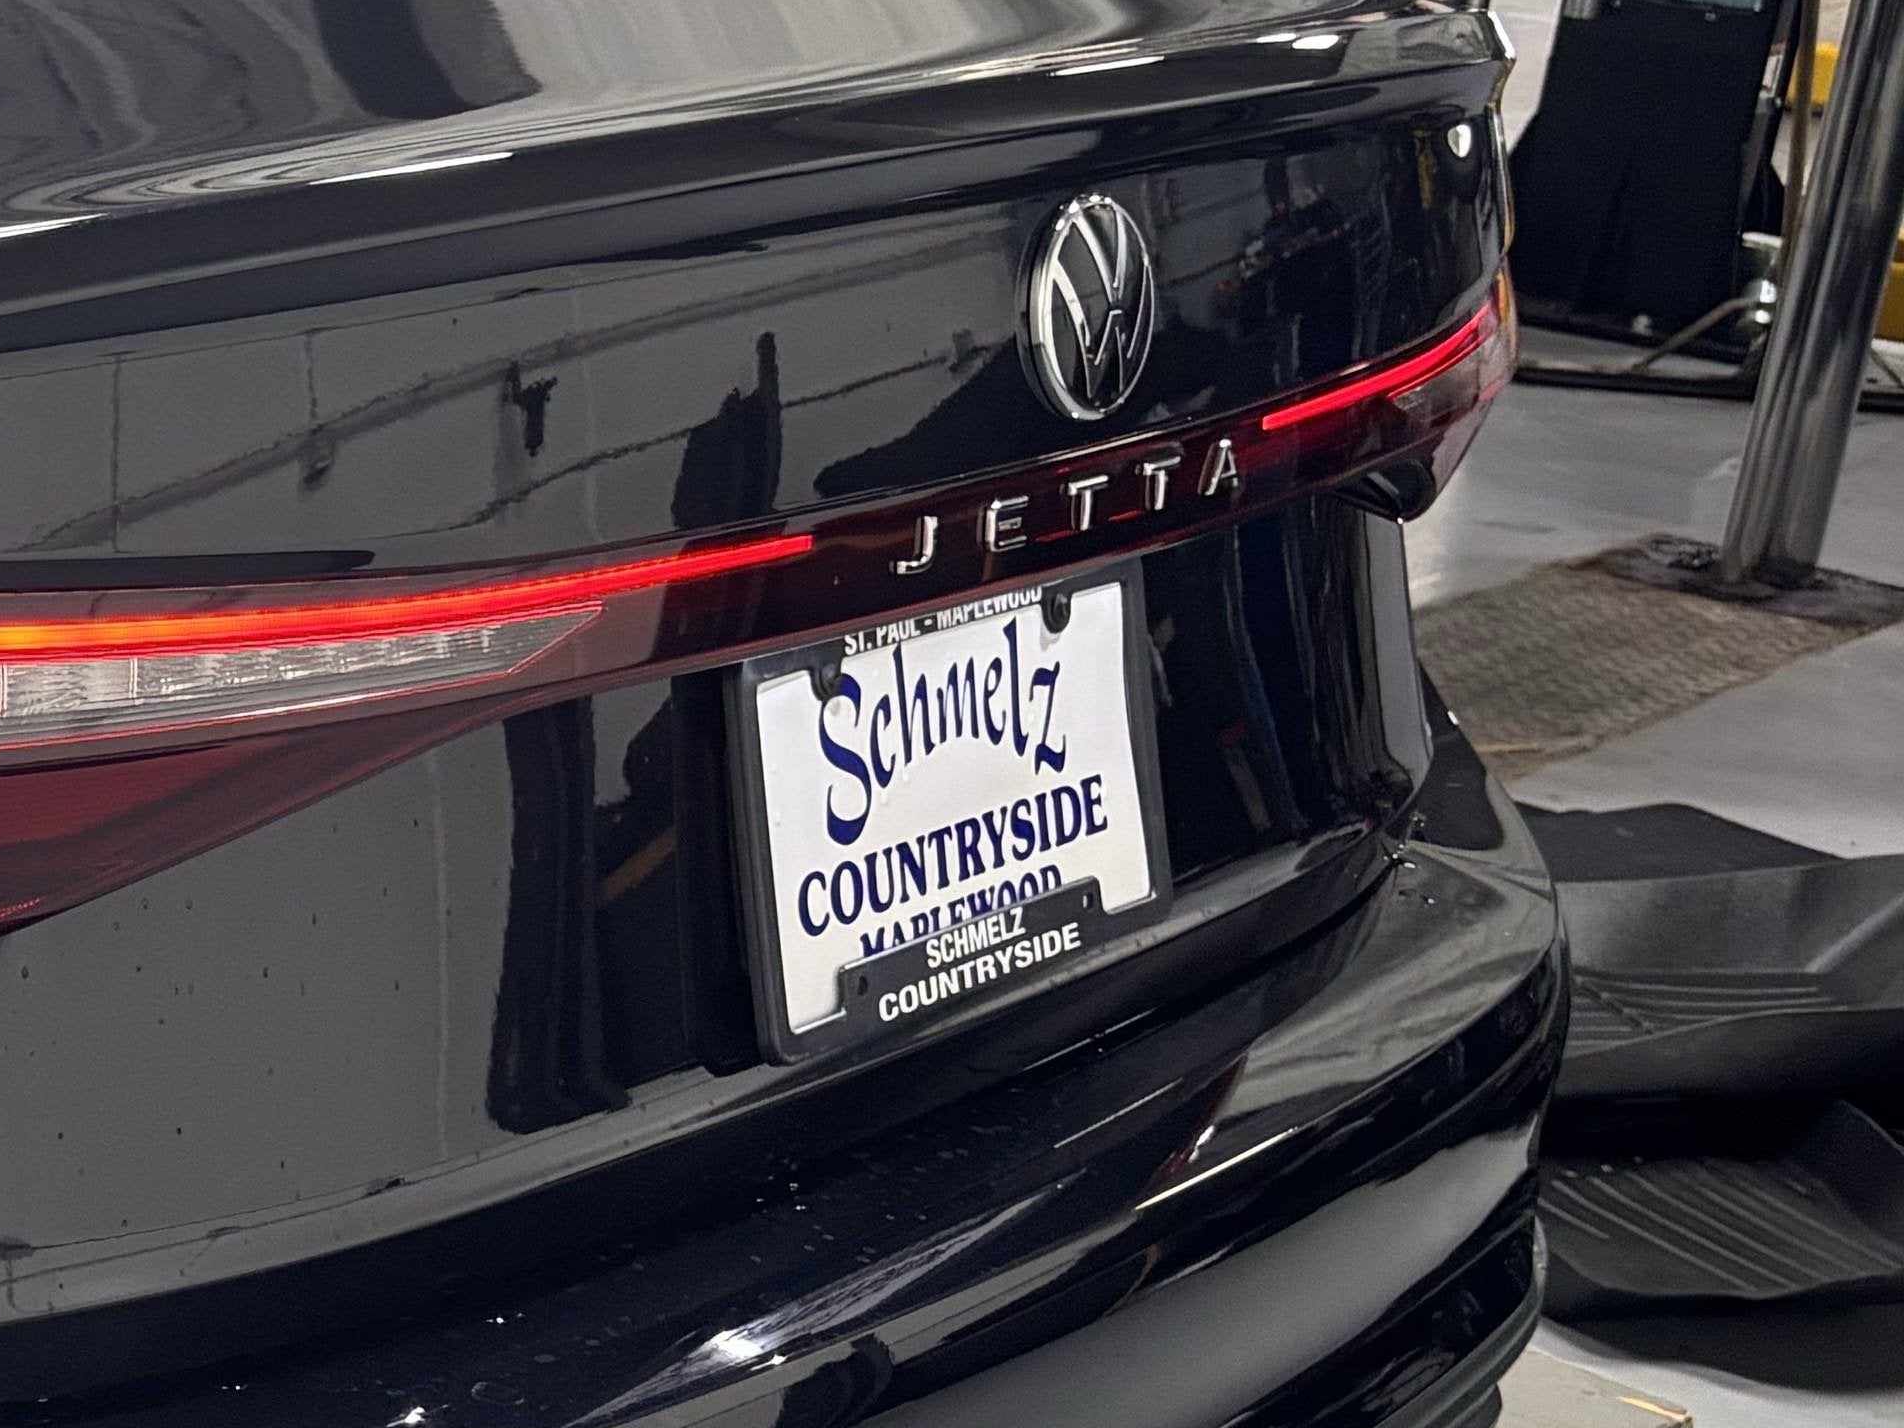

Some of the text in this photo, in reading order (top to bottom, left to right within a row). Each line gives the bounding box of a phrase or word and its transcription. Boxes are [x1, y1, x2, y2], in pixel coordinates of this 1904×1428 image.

[891, 438, 1241, 575] JETTA
[876, 619, 921, 646] PAUL
[819, 616, 1067, 846] Schmelz
[798, 774, 1108, 937] COUNTRYSIDE
[878, 922, 1082, 1022] COUNTRYSIDE
[925, 906, 1026, 968] SCHMELZ
